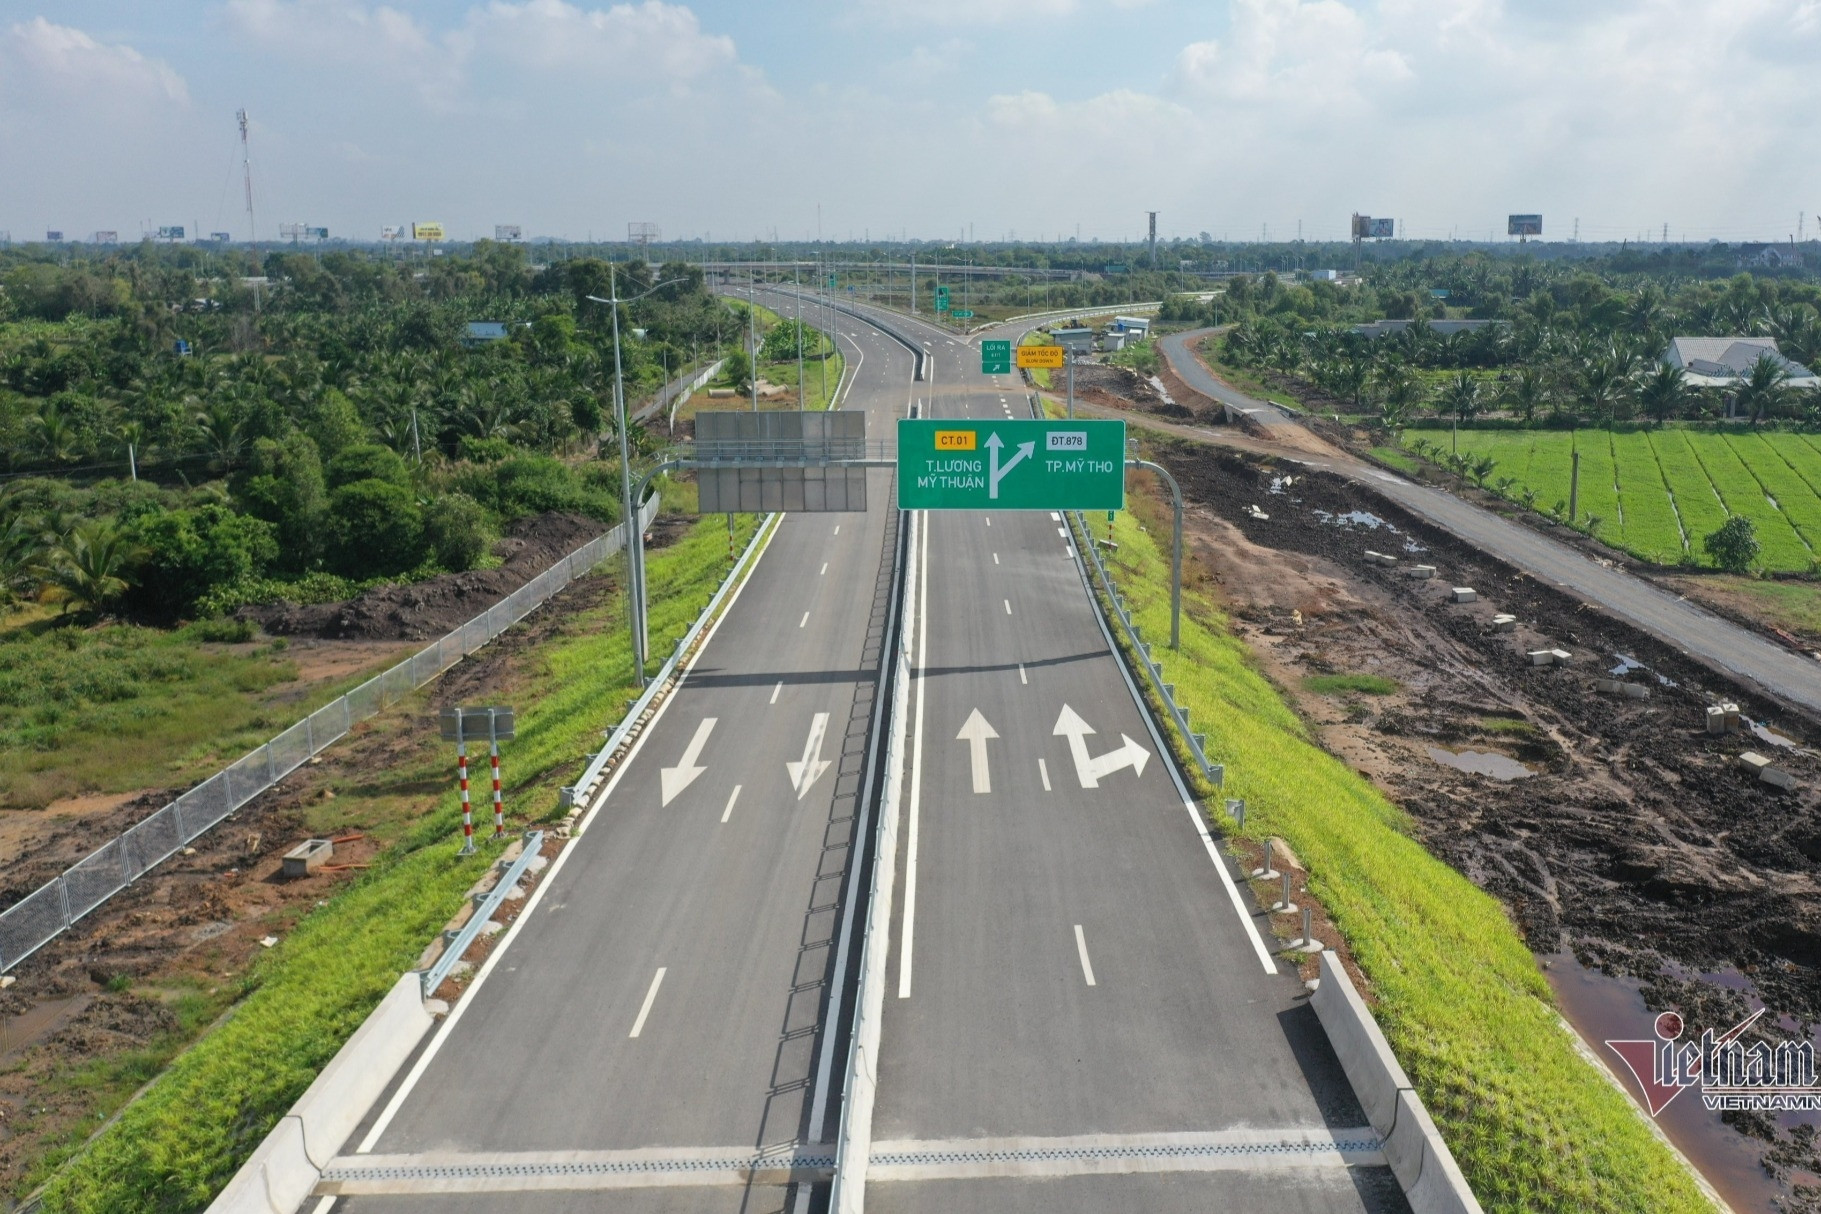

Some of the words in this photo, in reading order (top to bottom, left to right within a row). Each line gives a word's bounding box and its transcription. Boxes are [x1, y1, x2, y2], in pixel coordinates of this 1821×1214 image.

[941, 436, 968, 445] CT.01
[1051, 436, 1083, 446] ĐT.878
[926, 460, 982, 473] T.LƯƠNG
[1046, 458, 1084, 473] TP.MỸ
[1089, 460, 1113, 473] THO
[918, 474, 937, 488] MỸ
[940, 474, 984, 491] THUẬN
